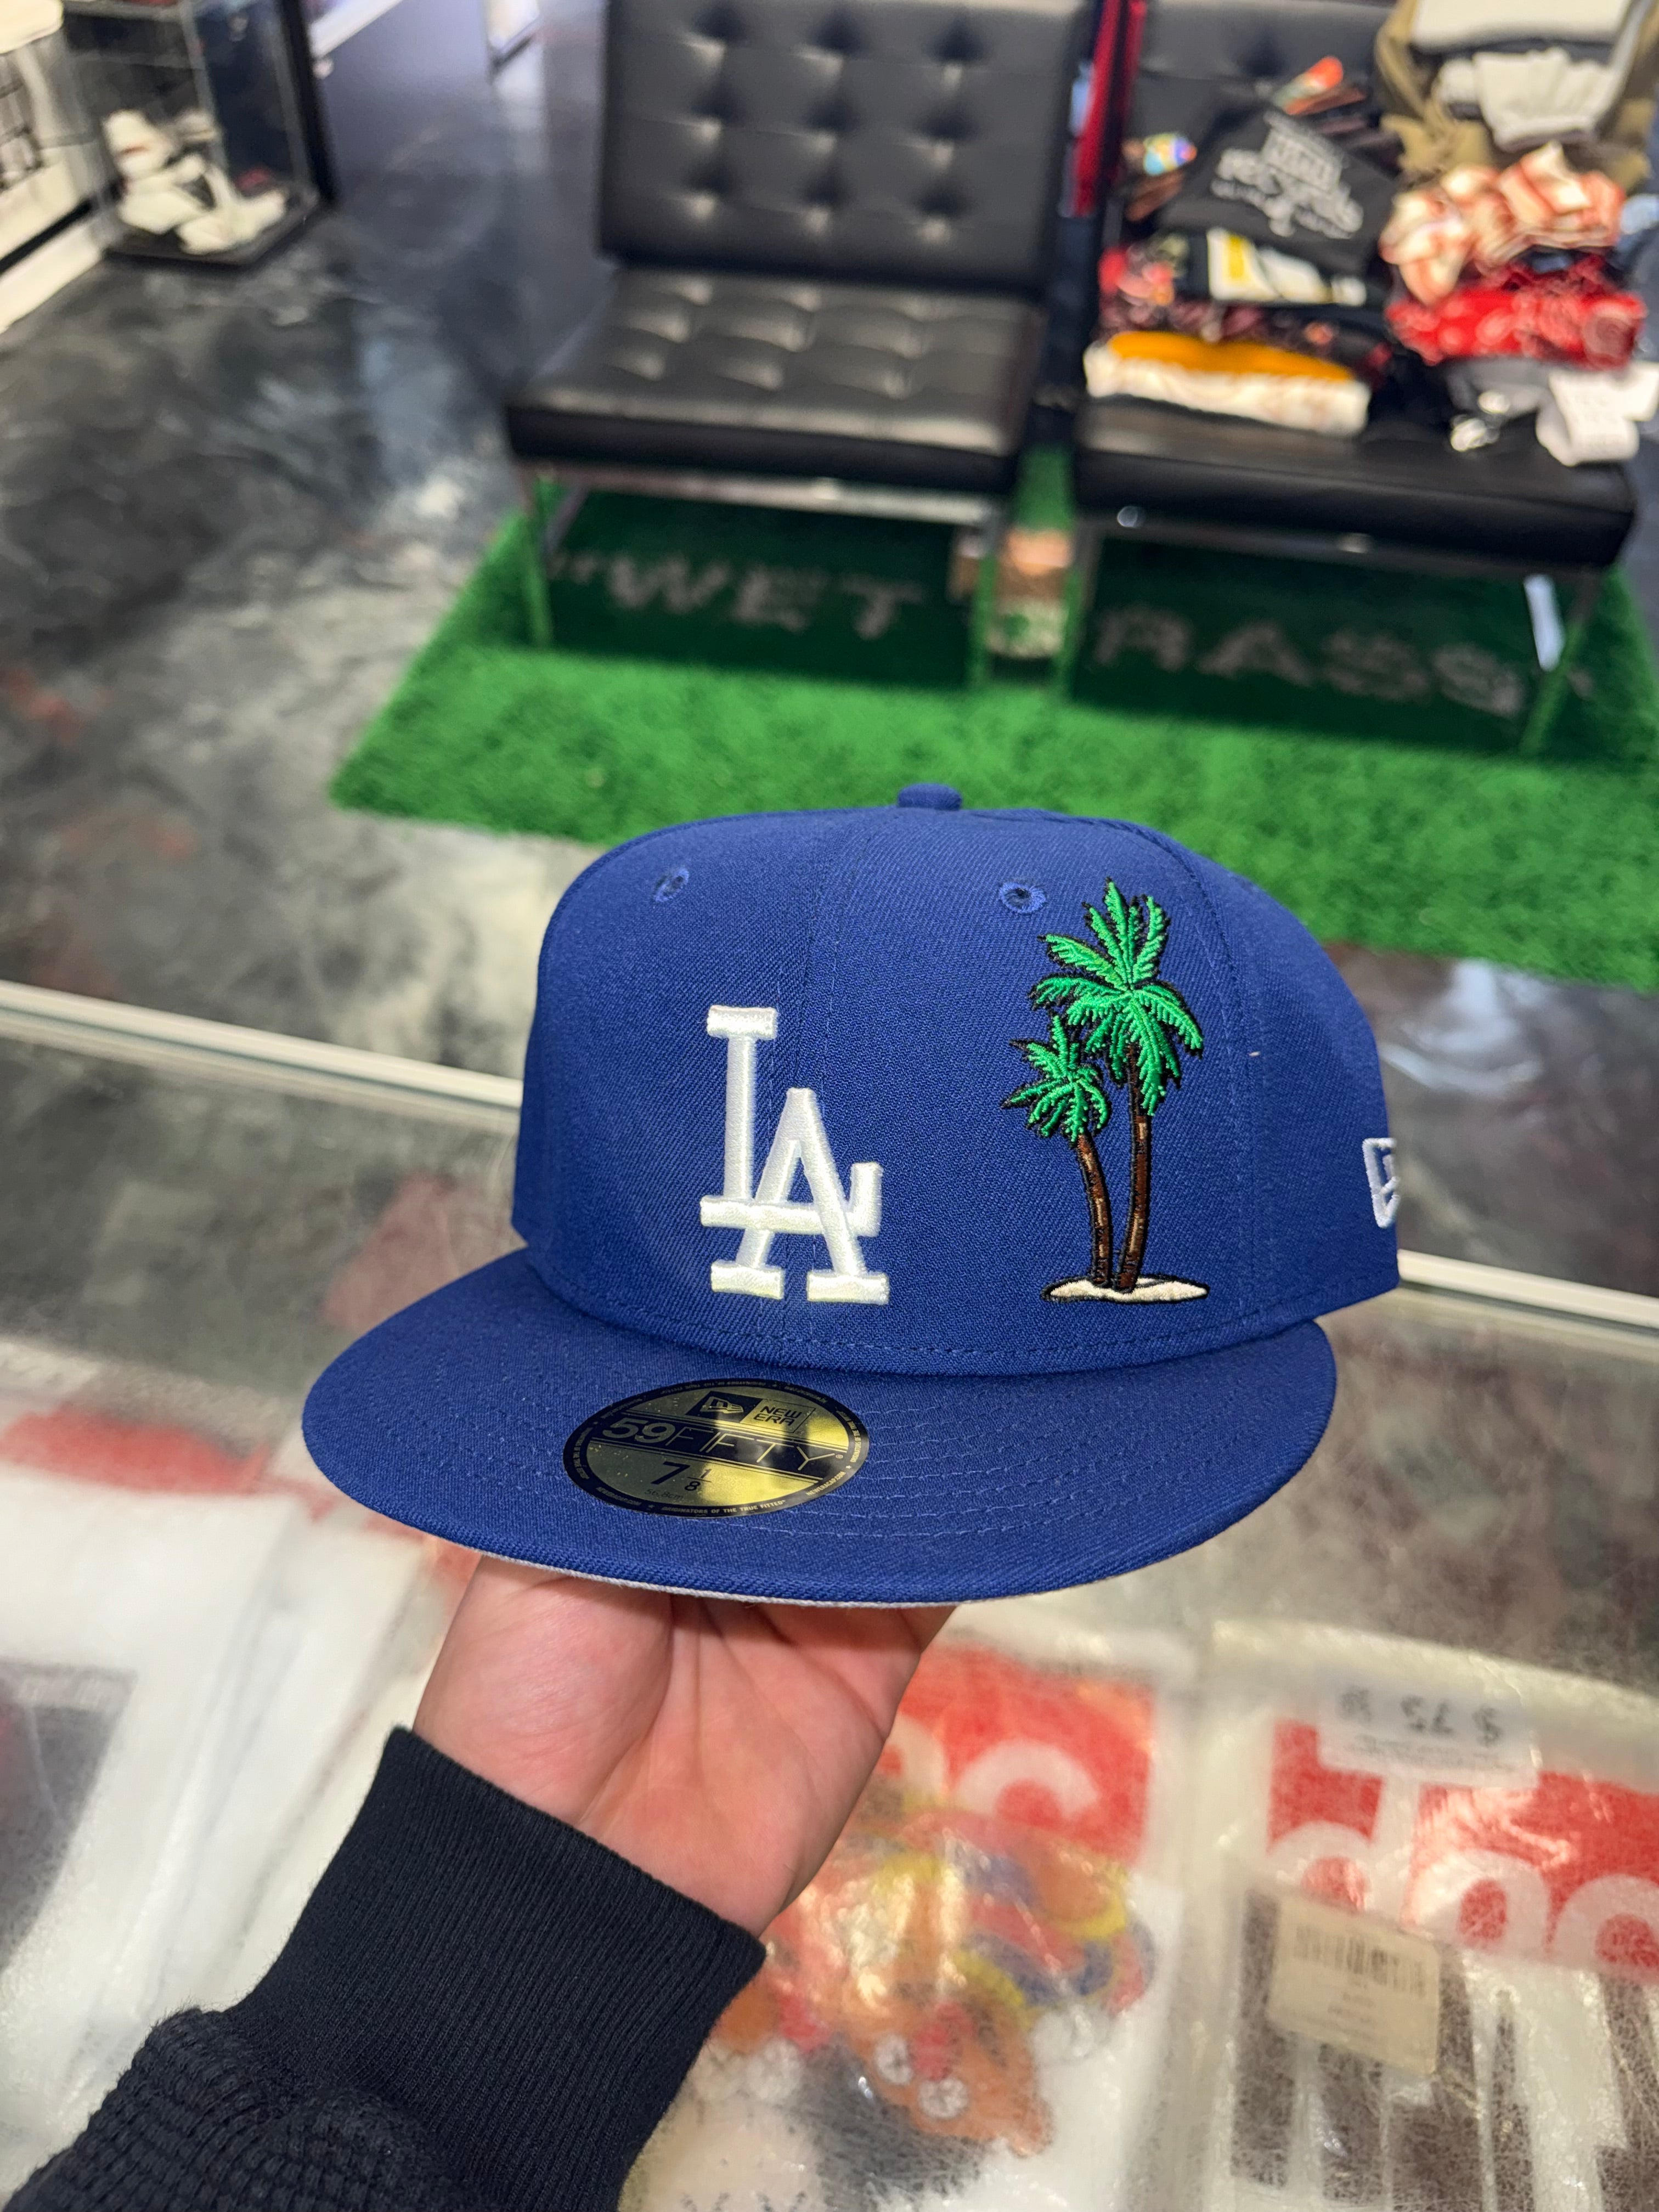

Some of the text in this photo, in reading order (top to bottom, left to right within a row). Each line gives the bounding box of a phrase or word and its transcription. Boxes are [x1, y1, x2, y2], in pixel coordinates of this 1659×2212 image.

[699, 1005, 890, 1306] LA
[753, 1414, 795, 1426] ERA
[760, 1406, 803, 1419] NEW
[651, 1461, 691, 1485] 7
